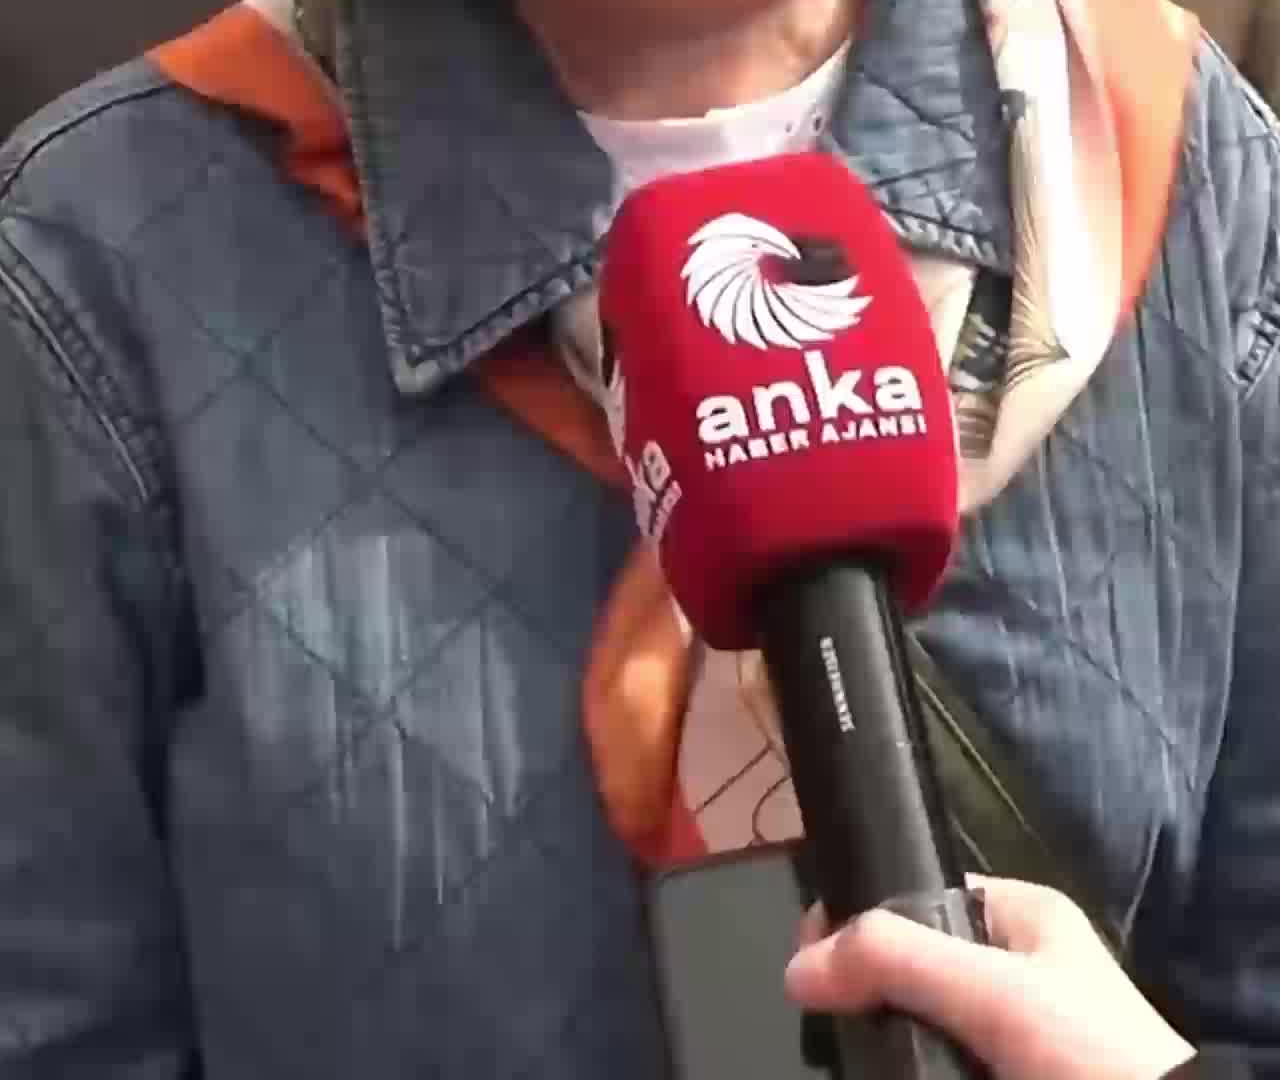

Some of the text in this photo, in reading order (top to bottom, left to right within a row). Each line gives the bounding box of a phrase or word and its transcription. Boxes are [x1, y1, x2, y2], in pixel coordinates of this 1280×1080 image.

[695, 349, 923, 445] anka
[703, 413, 928, 471] HABER AJANSI
